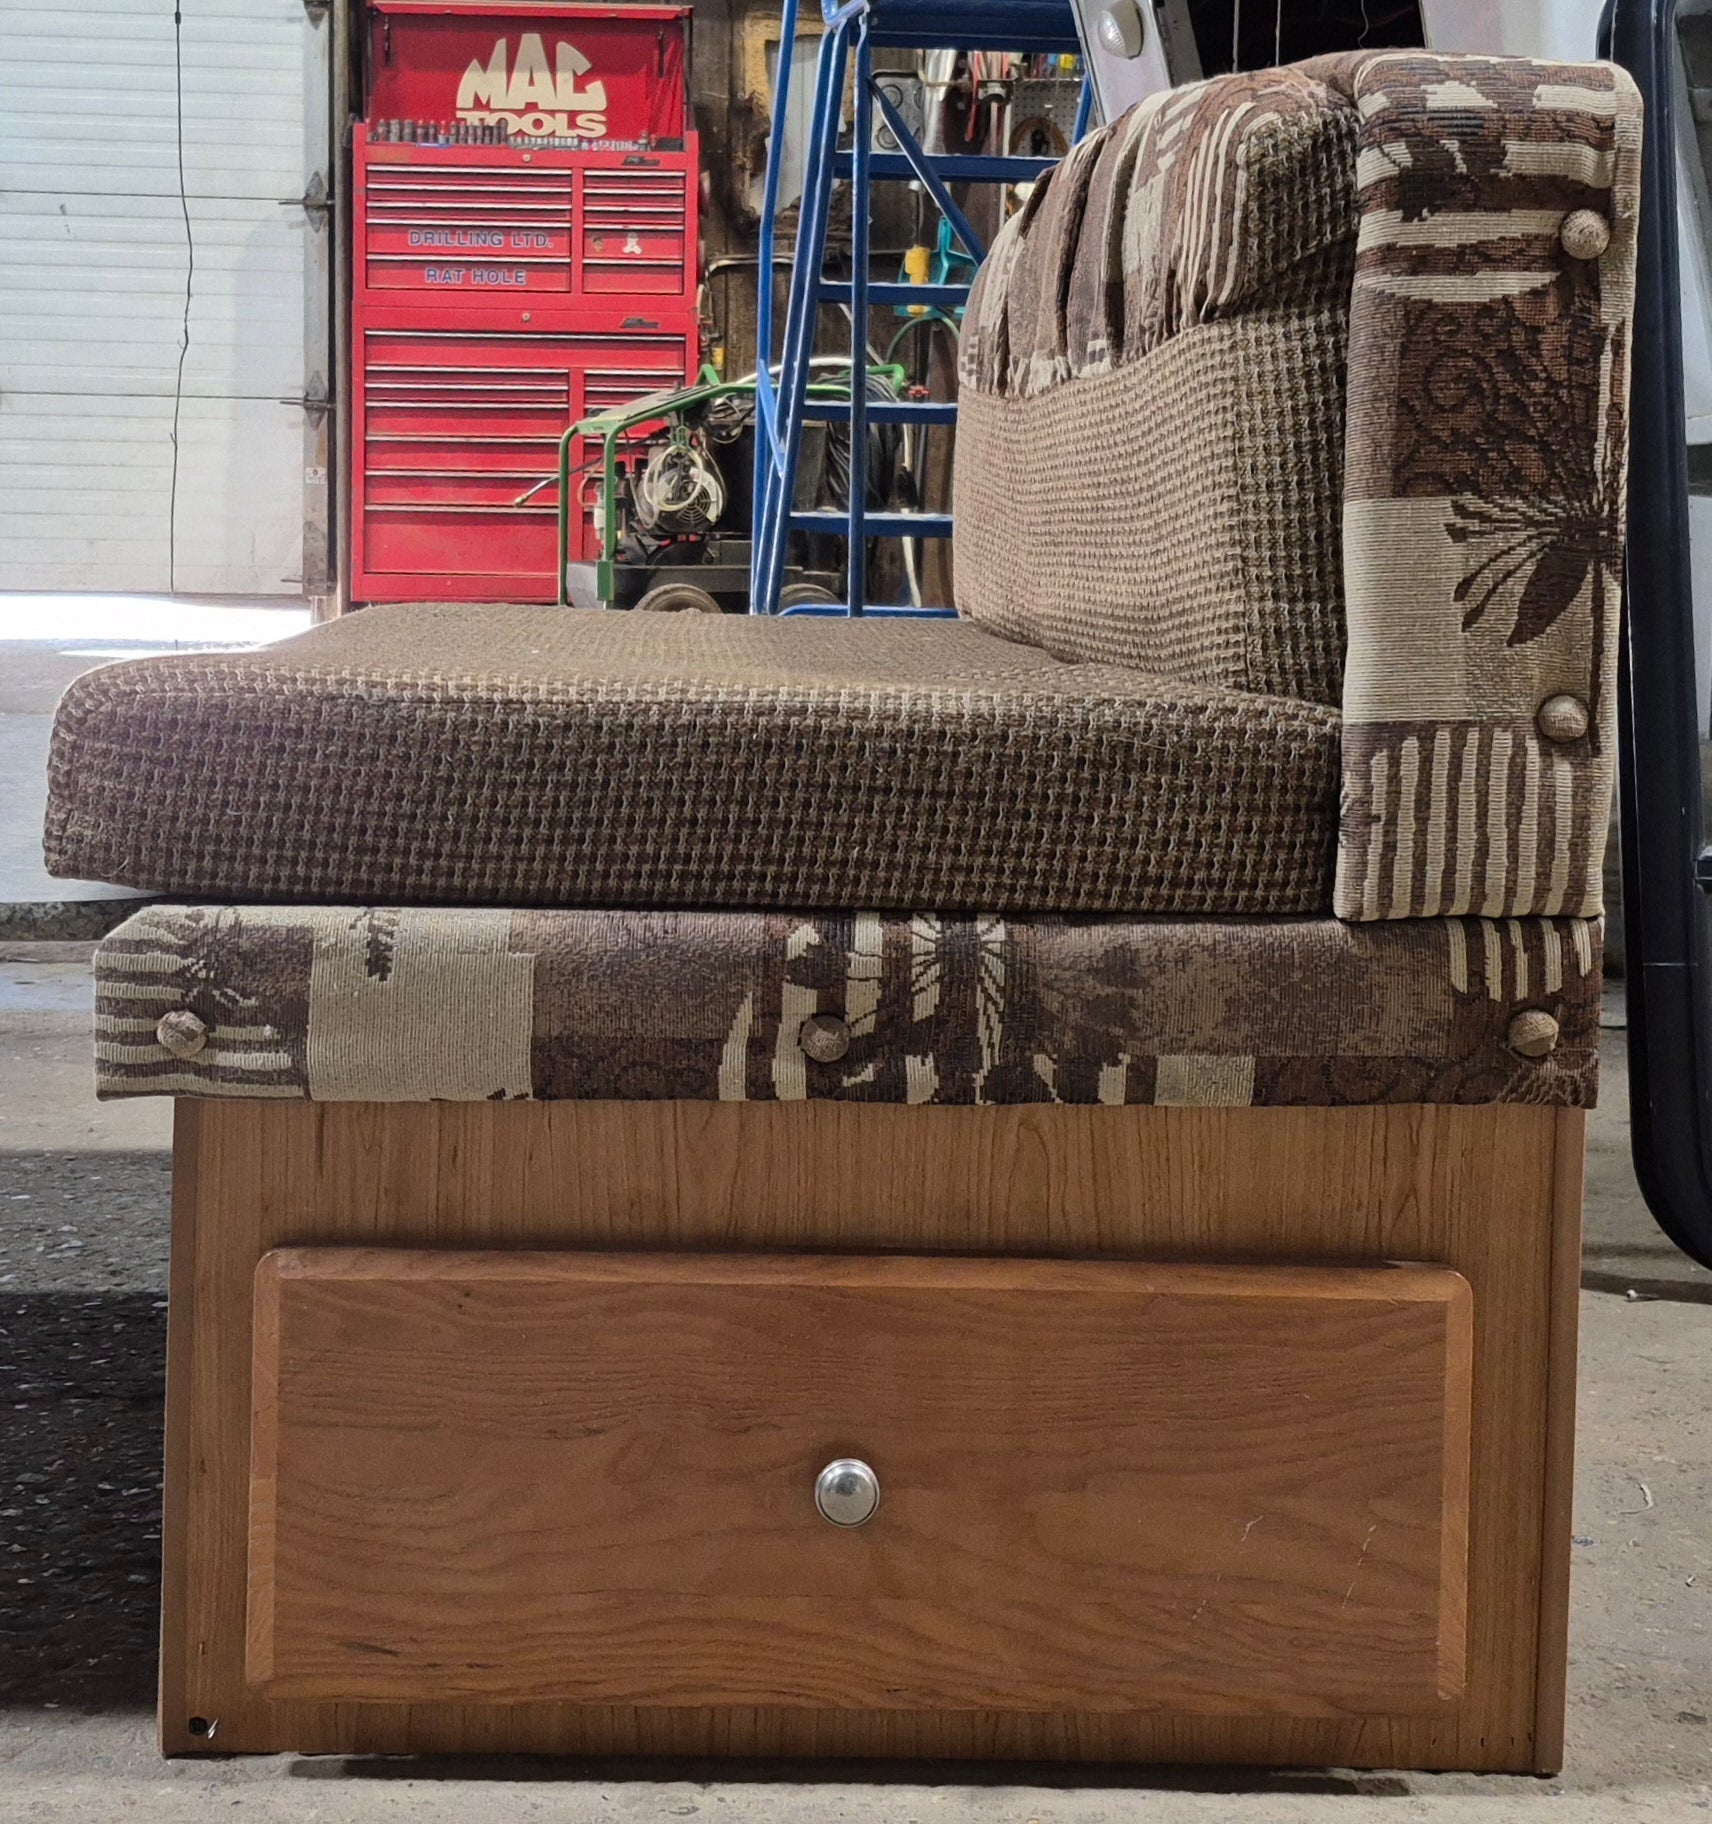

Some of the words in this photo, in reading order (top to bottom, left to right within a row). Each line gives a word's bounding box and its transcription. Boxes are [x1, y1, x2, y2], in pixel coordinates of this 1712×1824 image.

[456, 33, 607, 111] MAC
[409, 231, 503, 246] DRILLING
[512, 232, 554, 248] LTD.
[425, 267, 465, 284] RAT
[472, 269, 526, 285] HOLE
